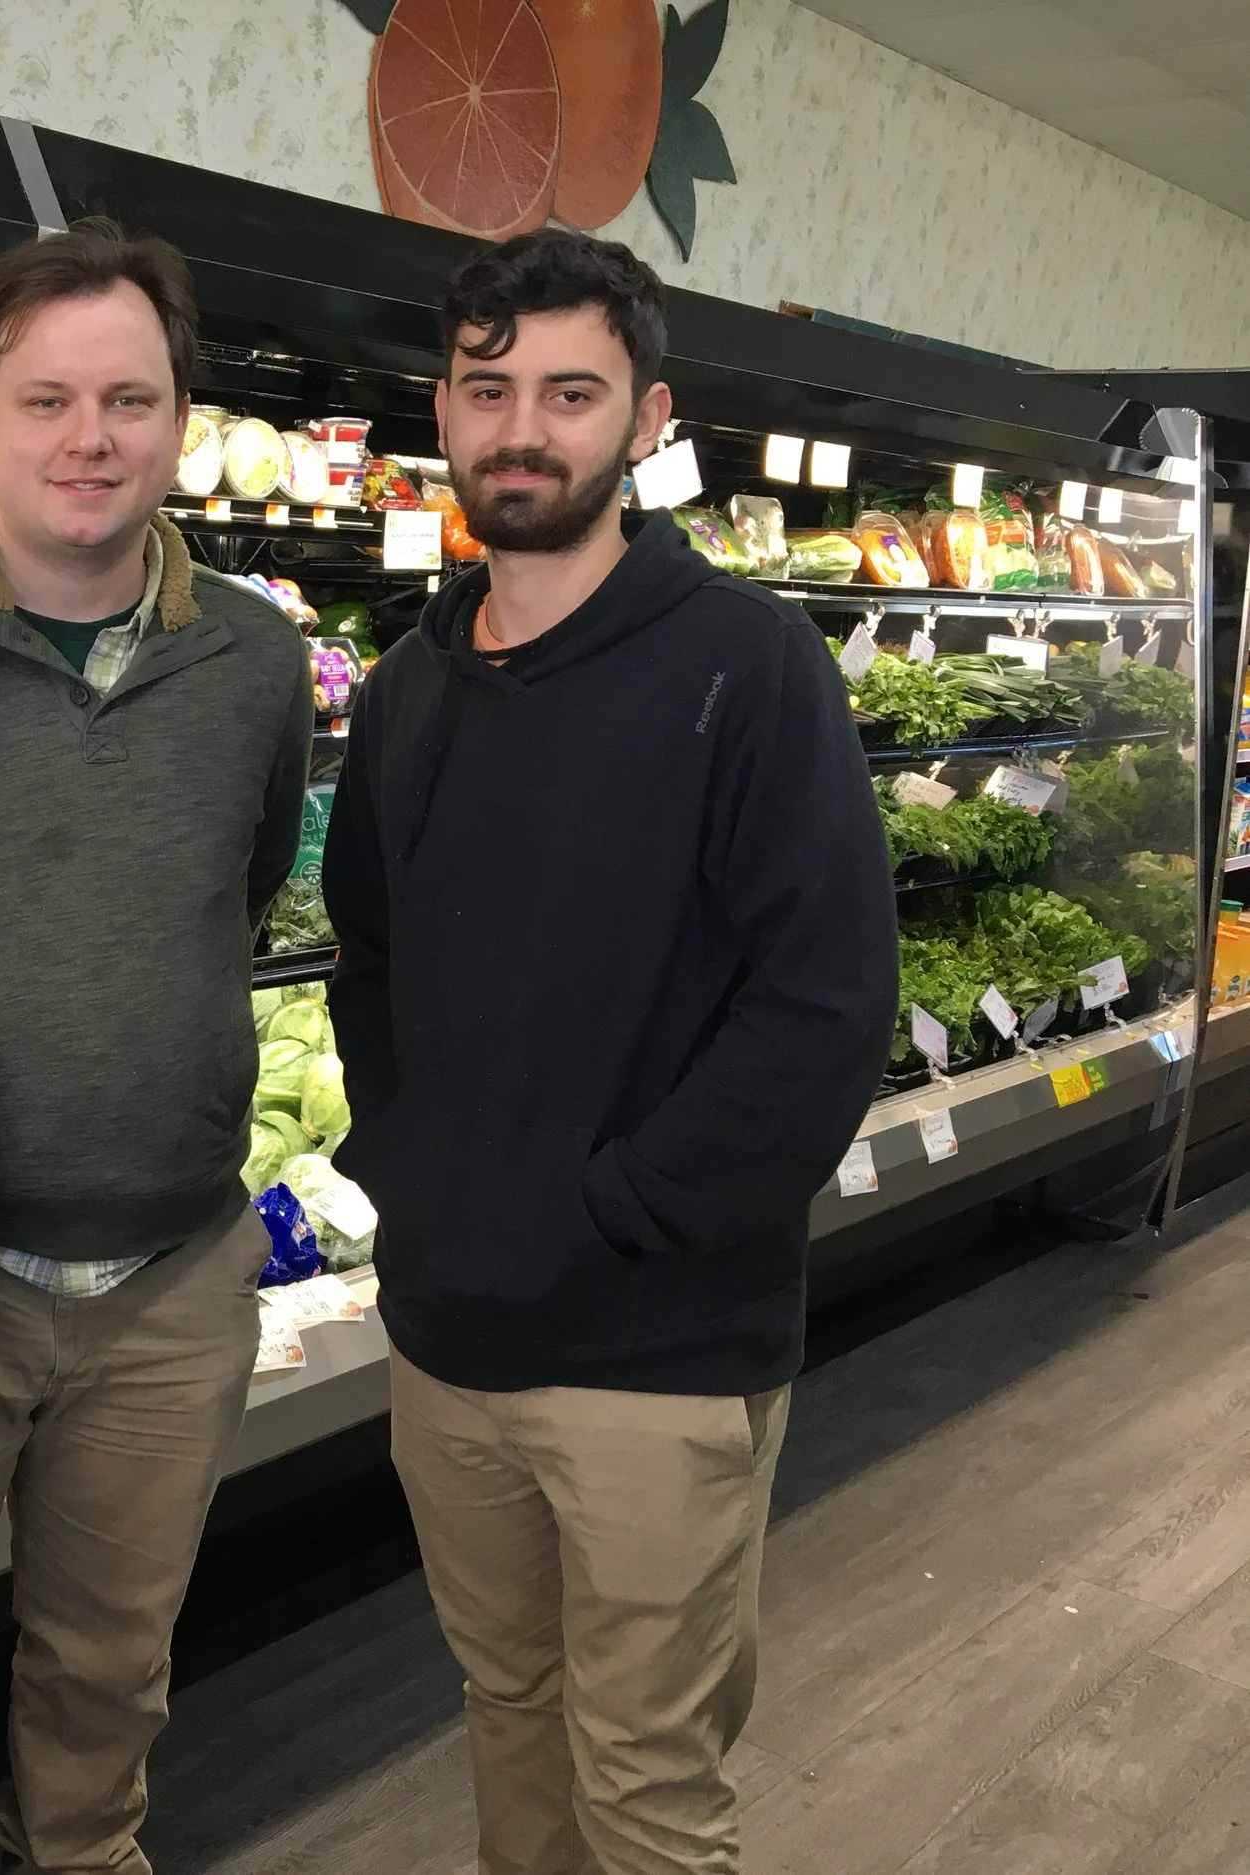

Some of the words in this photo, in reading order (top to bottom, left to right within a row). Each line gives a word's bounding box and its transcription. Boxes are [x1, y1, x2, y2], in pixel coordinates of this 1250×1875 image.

[695, 671, 727, 734] Reebok
[302, 810, 330, 832] ale
[302, 832, 327, 842] REEN
